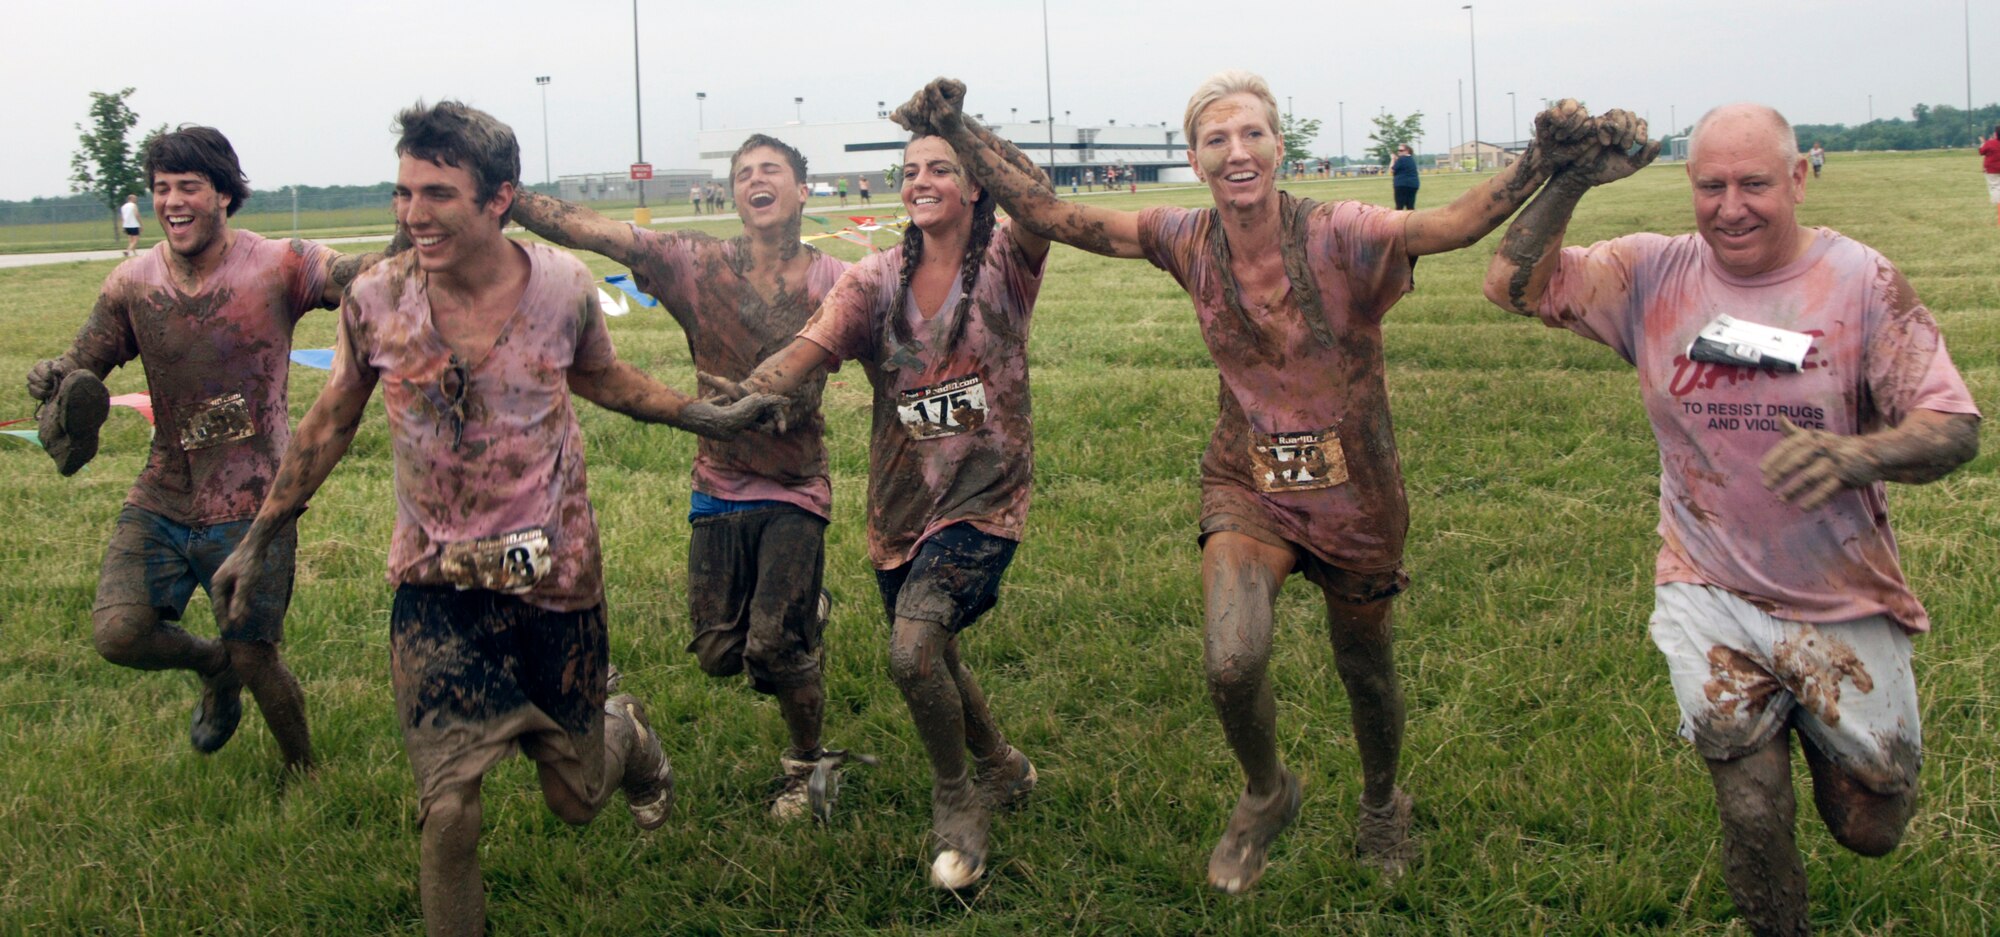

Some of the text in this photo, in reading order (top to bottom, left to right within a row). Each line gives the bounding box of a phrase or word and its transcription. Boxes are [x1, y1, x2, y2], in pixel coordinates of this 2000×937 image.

[913, 389, 973, 427] 175
[1683, 402, 1825, 420] TO RESIST DRUGS
[1708, 418, 1826, 432] AND VIOLCE
